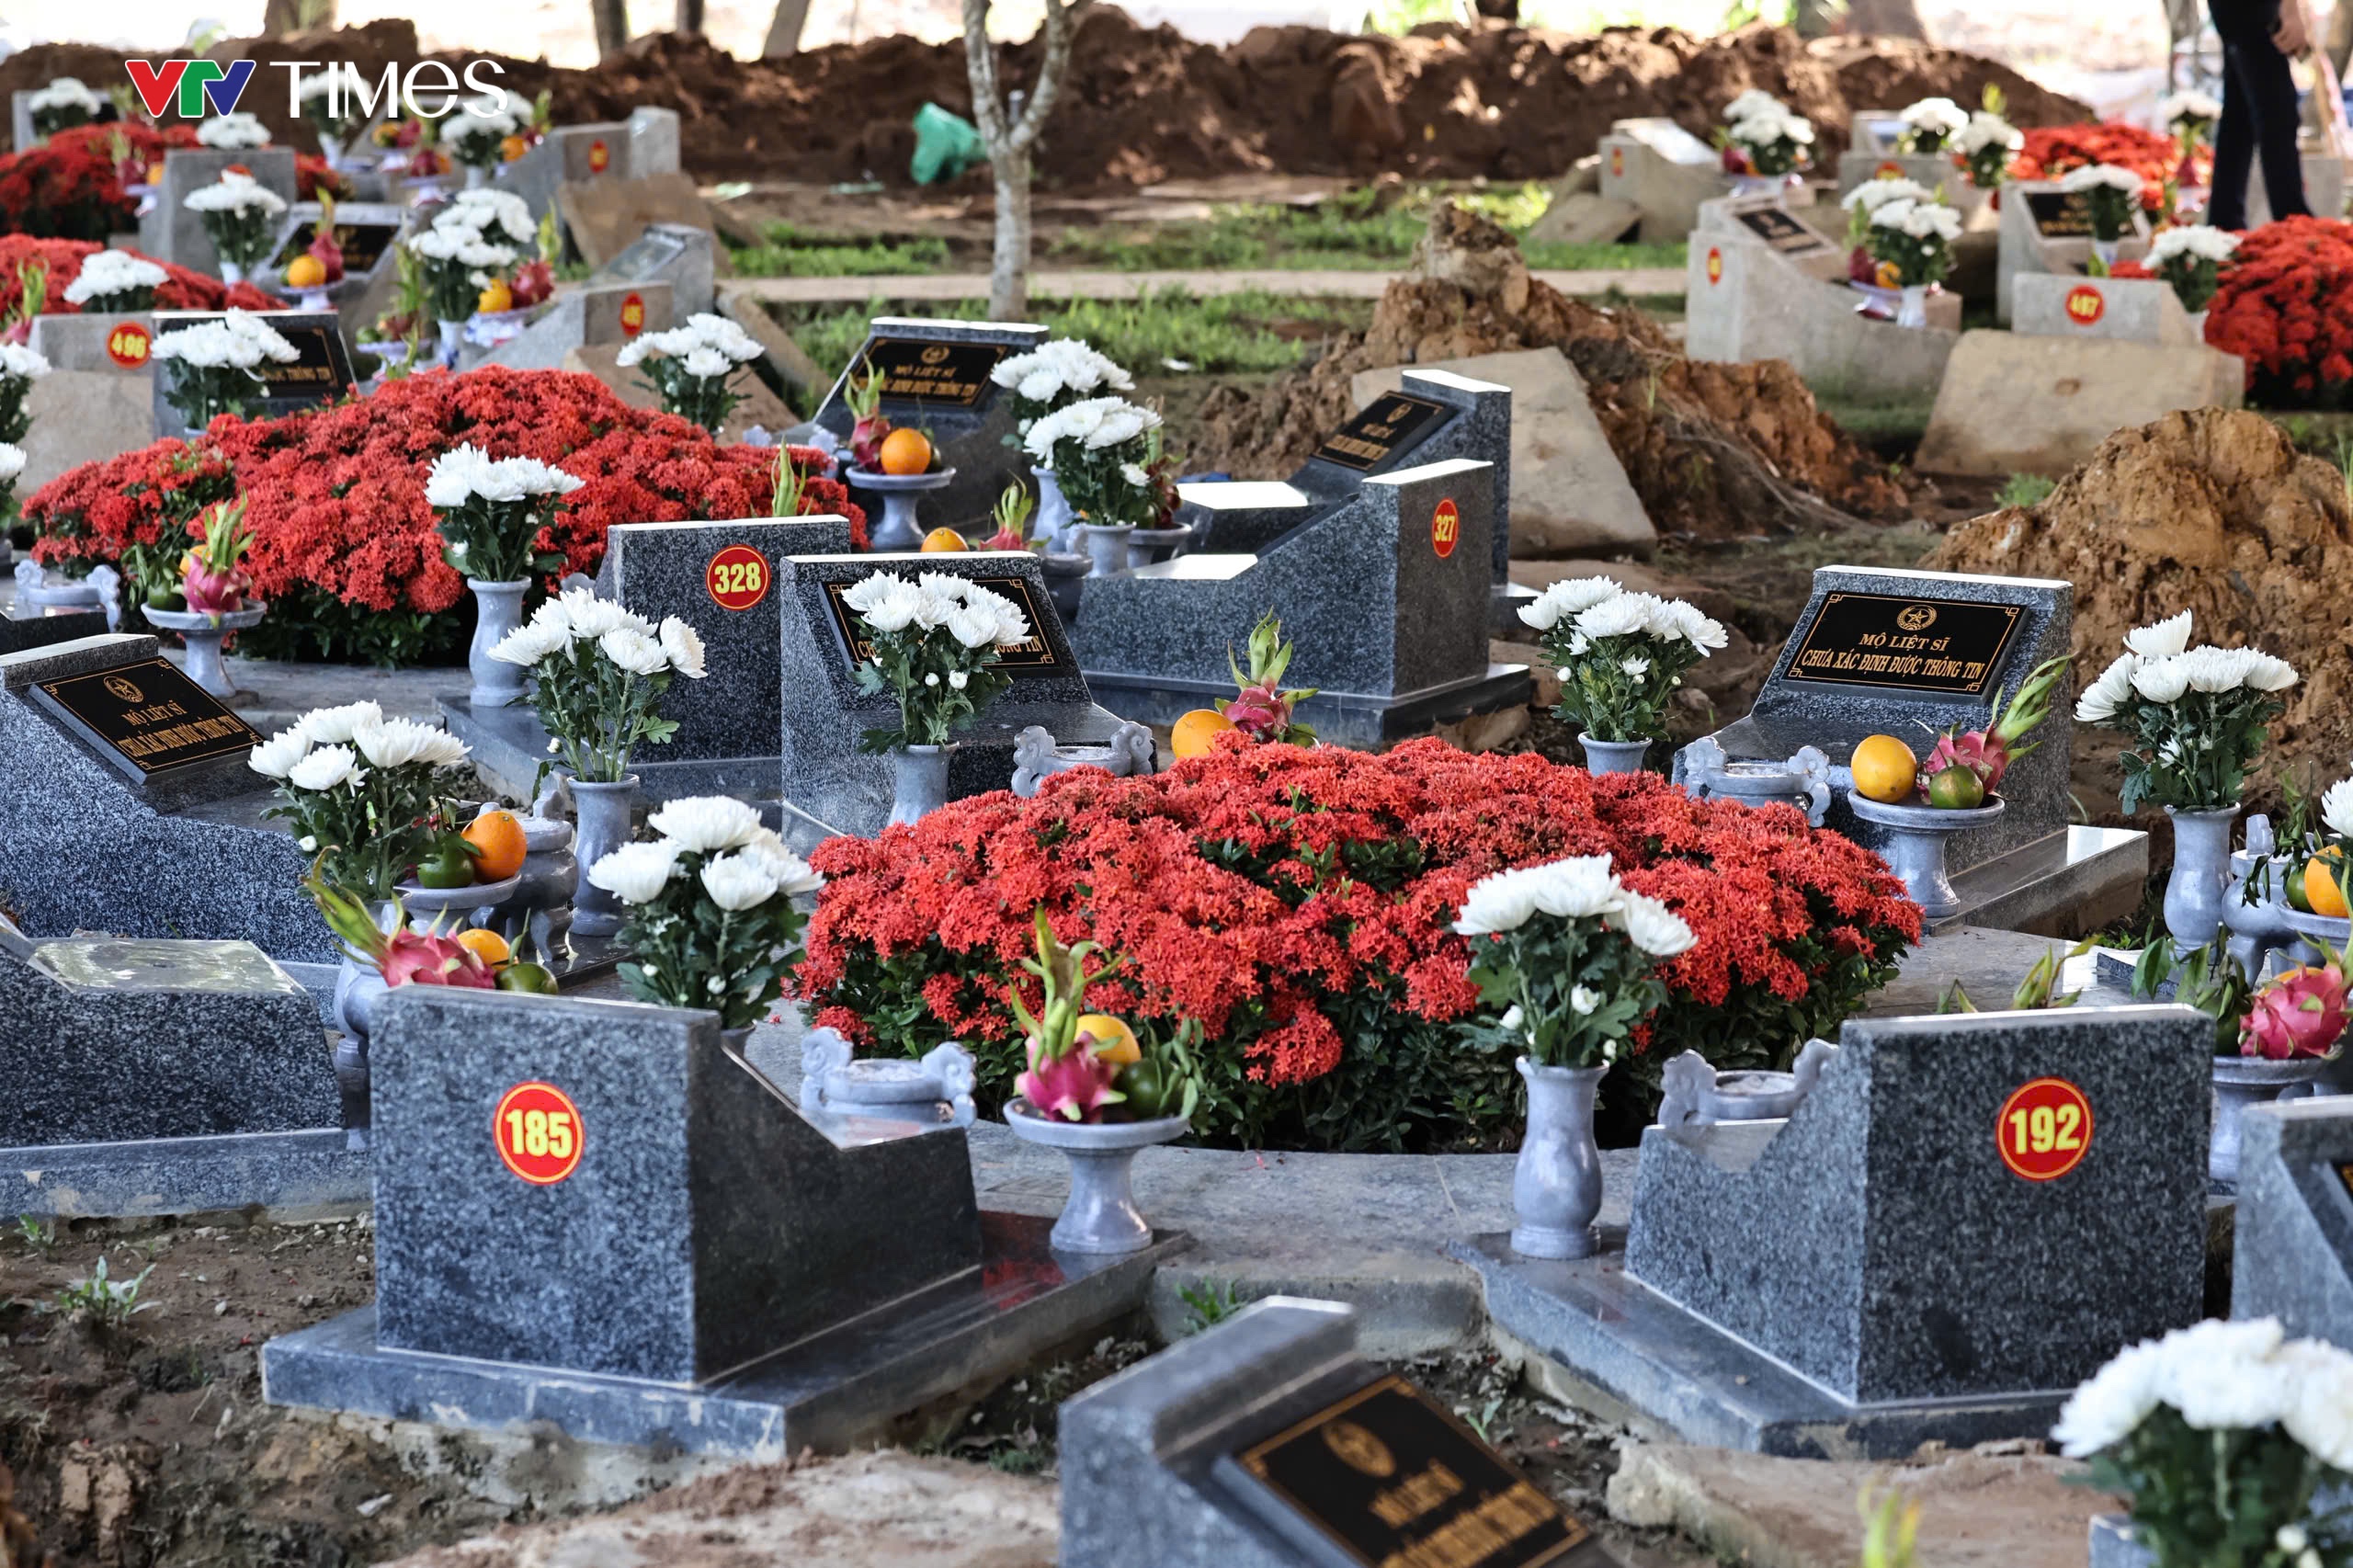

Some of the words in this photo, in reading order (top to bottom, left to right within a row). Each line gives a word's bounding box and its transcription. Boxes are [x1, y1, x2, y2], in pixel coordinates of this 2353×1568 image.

[1435, 515, 1457, 541] 327
[714, 562, 761, 595] 328
[1859, 632, 1887, 649] MỘ
[1889, 635, 1929, 653] LIỆT
[1930, 636, 1952, 652] SĨ
[1801, 649, 1833, 667] CHƯA
[1832, 648, 1860, 670] XÁC
[1860, 654, 1888, 676] ĐỊNH
[1887, 654, 1923, 679] ĐƯỢC
[1923, 656, 1963, 678] THÔNG
[1961, 662, 1986, 680] TIN
[121, 709, 150, 726] MỘ
[140, 704, 174, 722] LIỆT
[506, 1108, 574, 1158] 185
[2008, 1103, 2081, 1154] 192
